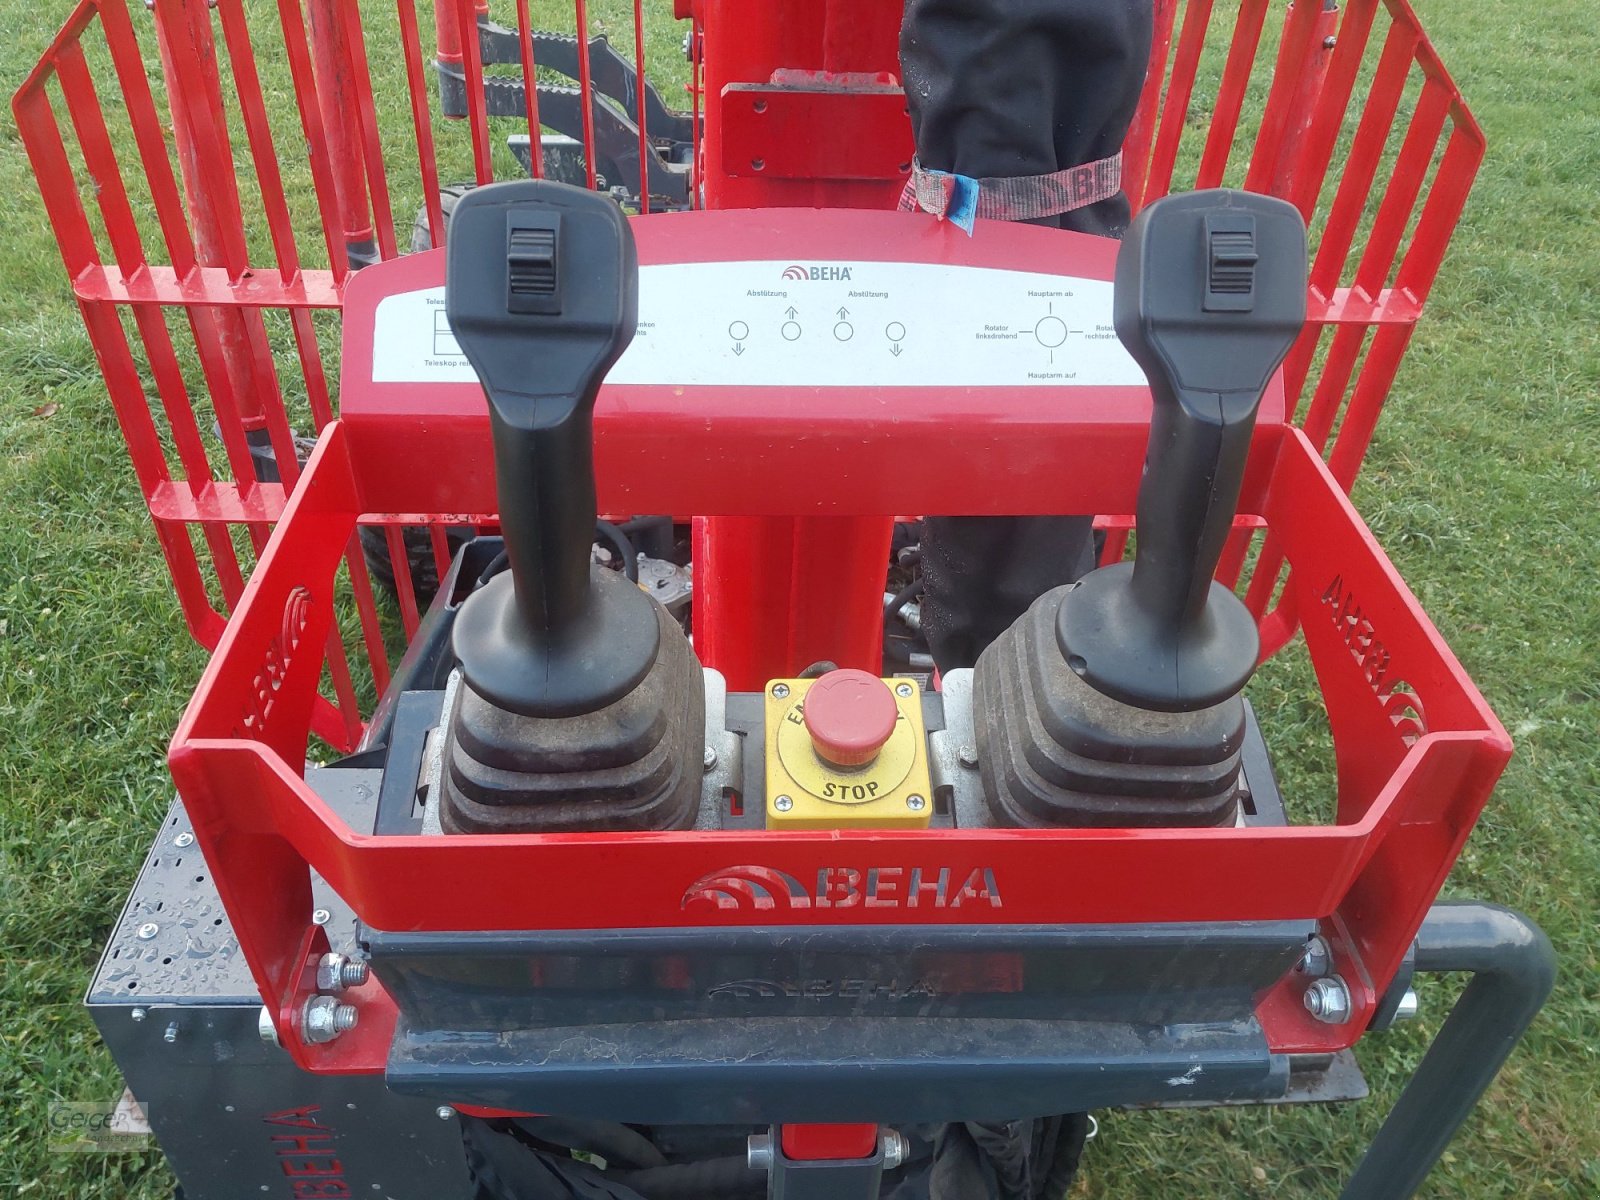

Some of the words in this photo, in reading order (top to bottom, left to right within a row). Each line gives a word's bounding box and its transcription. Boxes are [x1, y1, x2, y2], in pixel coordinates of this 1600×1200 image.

[747, 289, 788, 298] Abstützung
[848, 290, 889, 299] Abstützung
[1027, 290, 1063, 298] Hauptarm
[984, 324, 1009, 332] Rotator
[424, 359, 458, 367] Teleskop
[1027, 371, 1063, 379] Hauptarm
[1064, 371, 1077, 379] auf
[822, 780, 880, 801] STOP
[815, 867, 1003, 908] BEHA
[263, 1103, 352, 1200] BEHA
